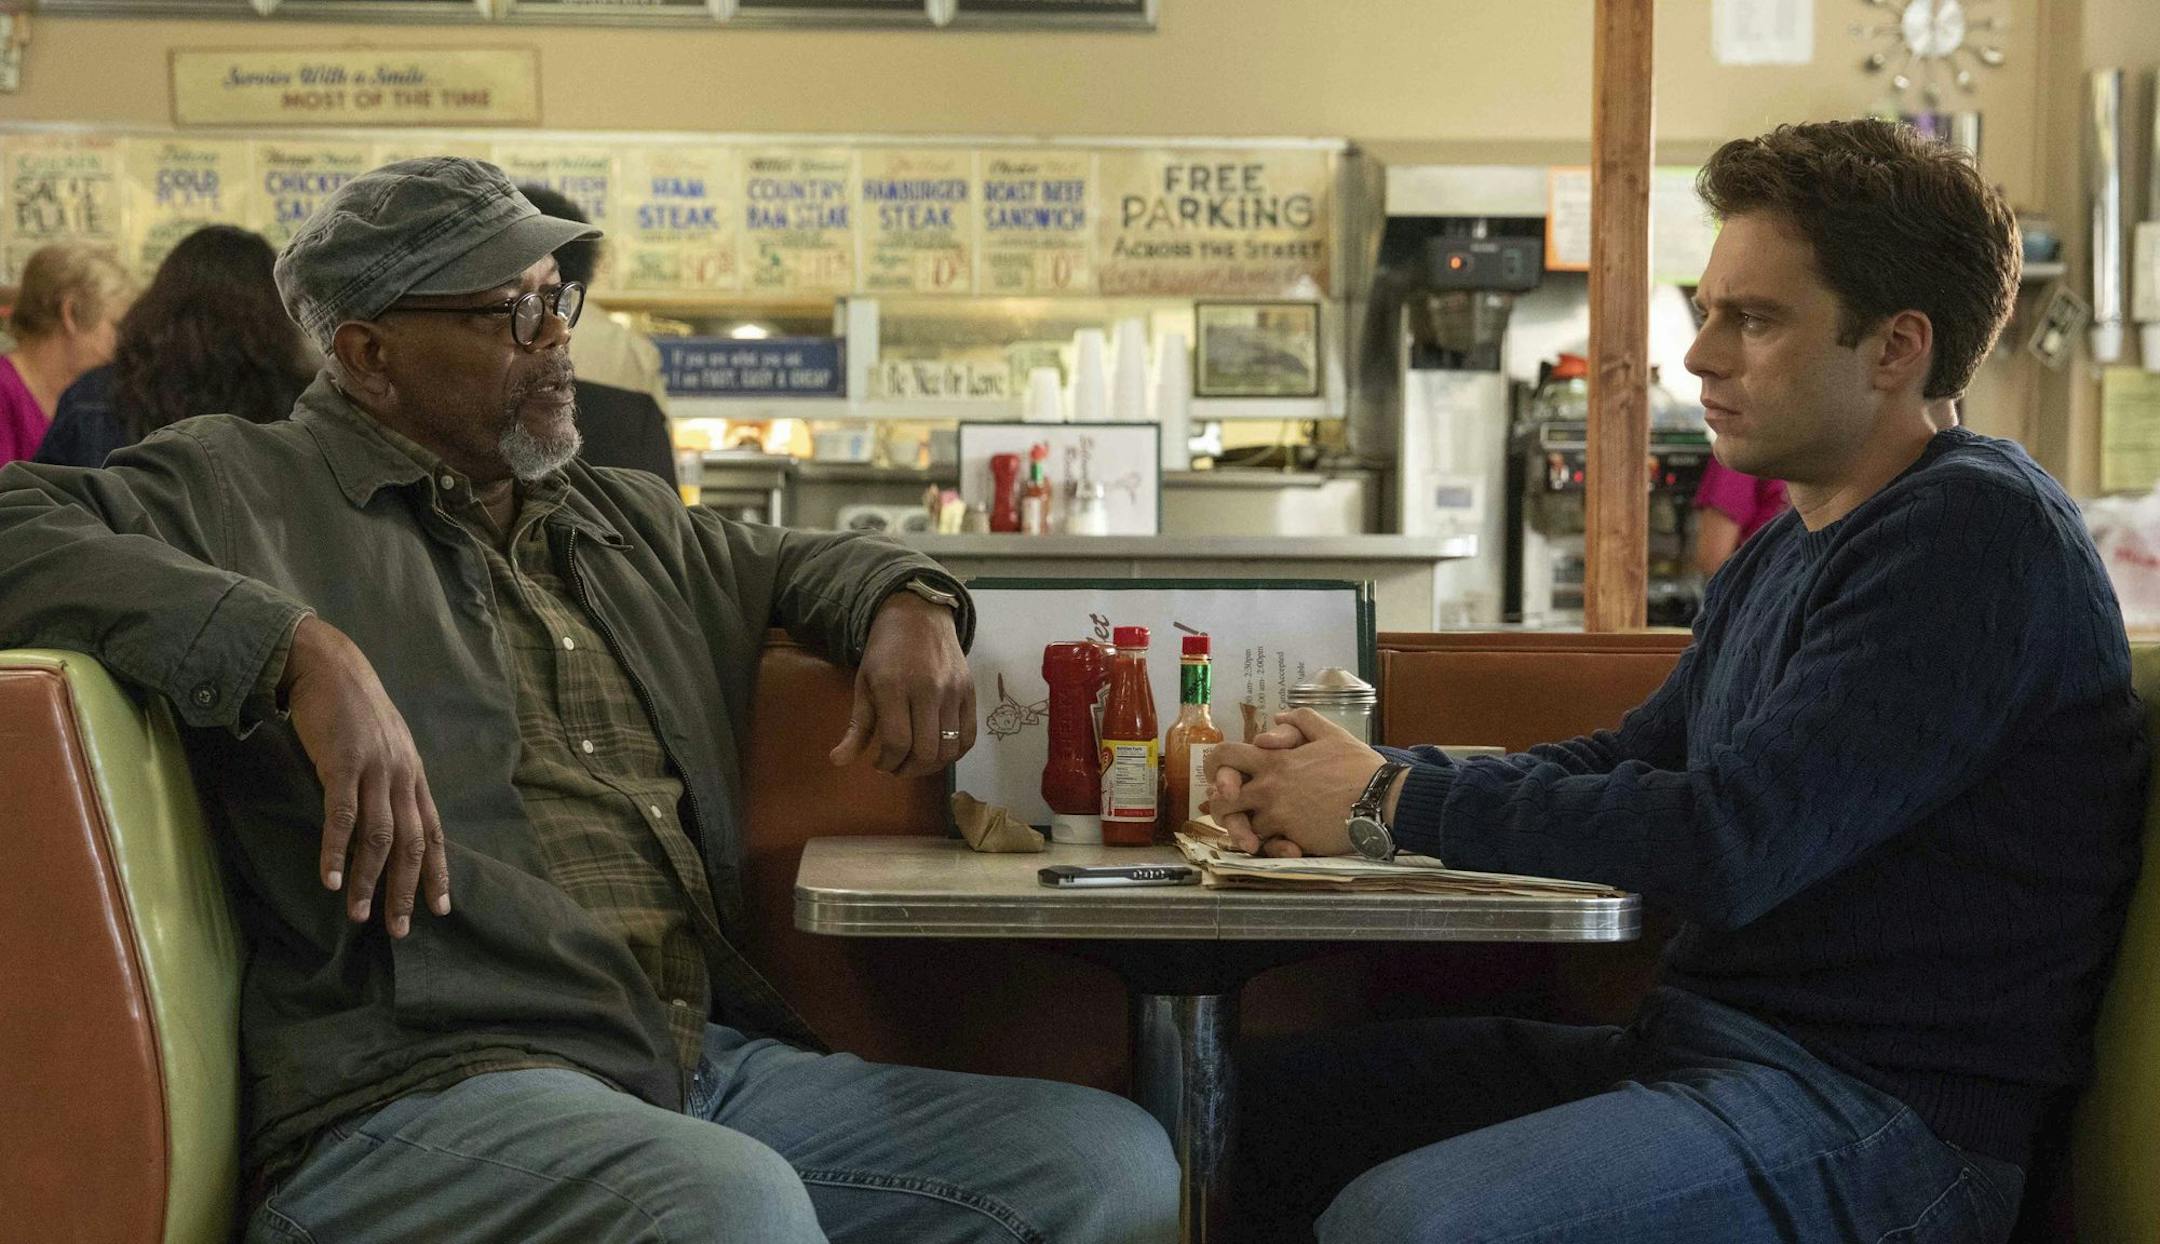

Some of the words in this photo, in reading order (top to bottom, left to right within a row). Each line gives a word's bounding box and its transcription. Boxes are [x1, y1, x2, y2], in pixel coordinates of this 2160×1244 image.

[282, 91, 345, 110] MOST
[354, 91, 382, 110] OF
[393, 90, 431, 109] THE
[441, 89, 490, 108] TIME
[264, 171, 356, 195] CHICKE
[651, 178, 706, 198] HAM
[747, 178, 847, 200] COUNTRY
[862, 178, 970, 201] HAMBURGER
[984, 179, 1037, 201] ROAST
[1041, 179, 1086, 201] BEEF
[1164, 164, 1265, 192] FREE
[637, 205, 719, 231] STEAK
[747, 205, 788, 229] HAM
[878, 205, 956, 231] STEAK
[984, 207, 1087, 231] SANDWICH
[1121, 195, 1314, 230] PARKING
[1276, 650, 1287, 687] Accepted
